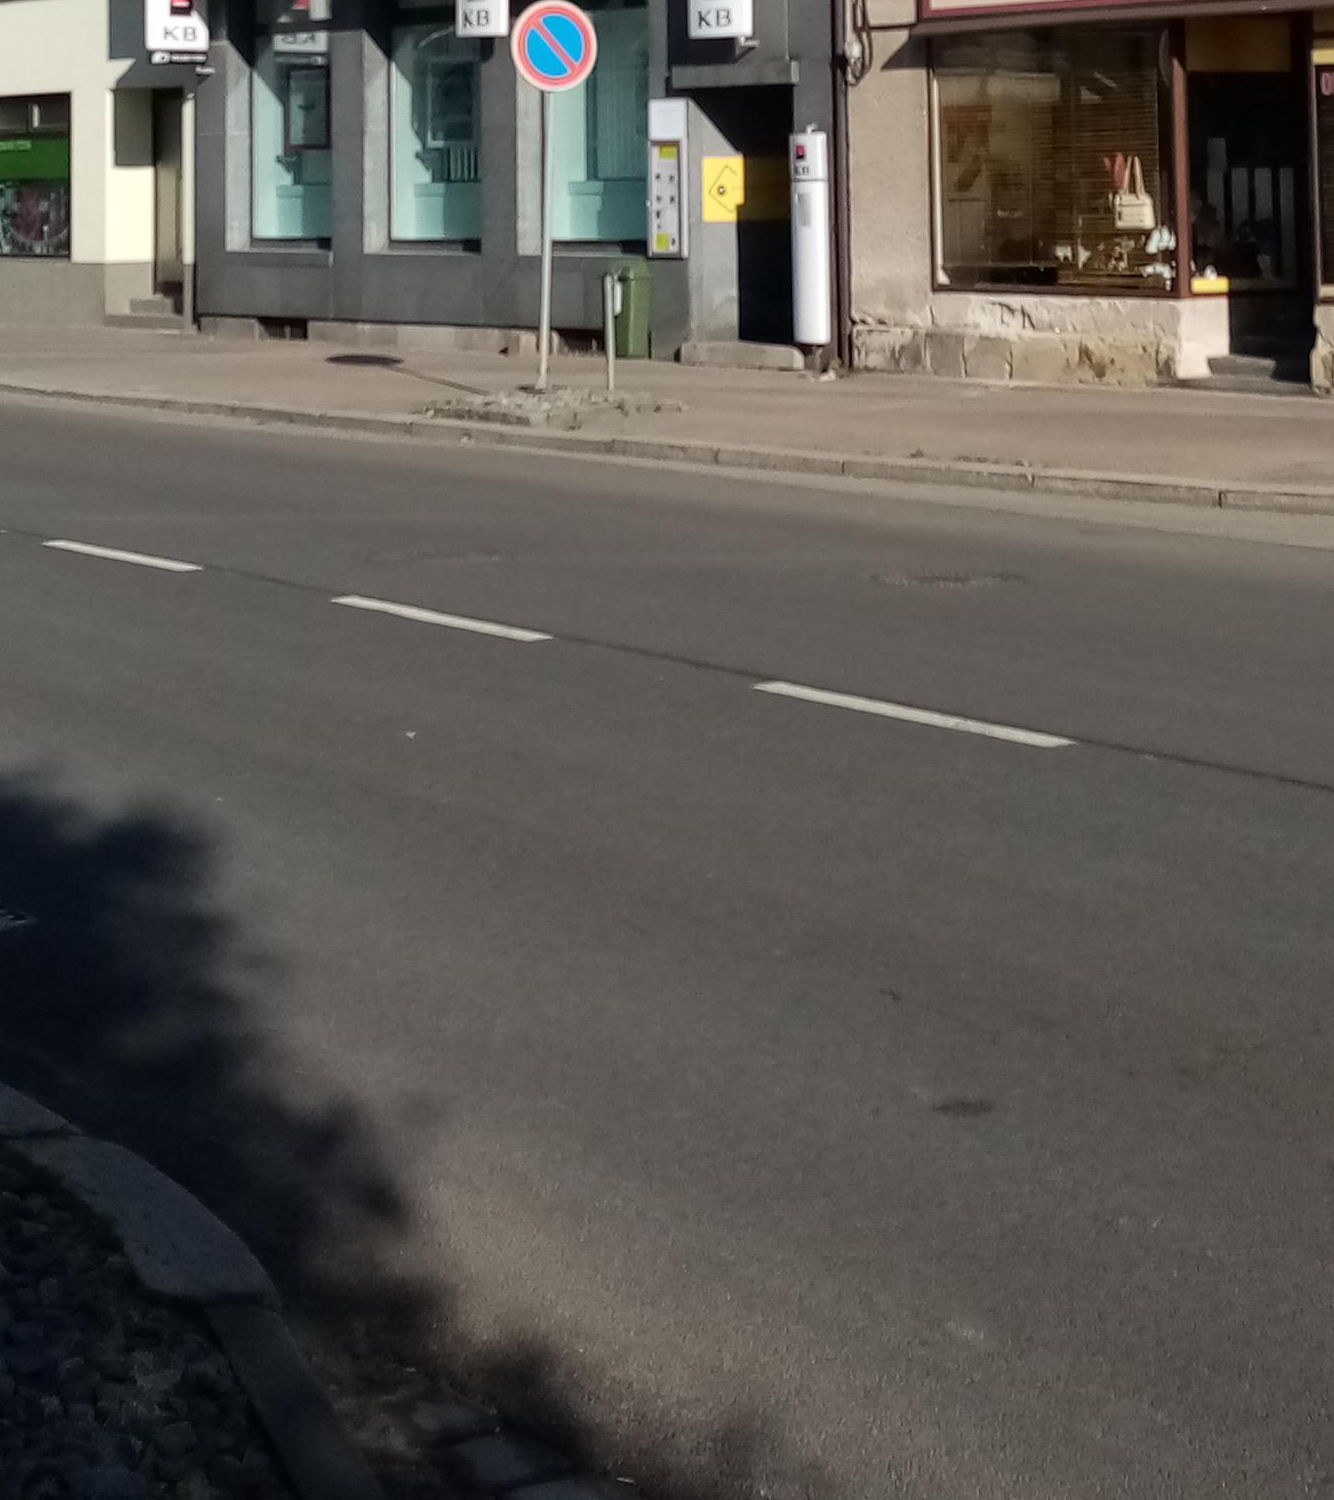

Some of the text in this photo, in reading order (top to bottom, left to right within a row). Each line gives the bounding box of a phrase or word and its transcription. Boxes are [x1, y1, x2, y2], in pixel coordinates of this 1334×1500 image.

[461, 9, 491, 29] KB
[697, 9, 732, 29] KB
[163, 26, 198, 42] KB
